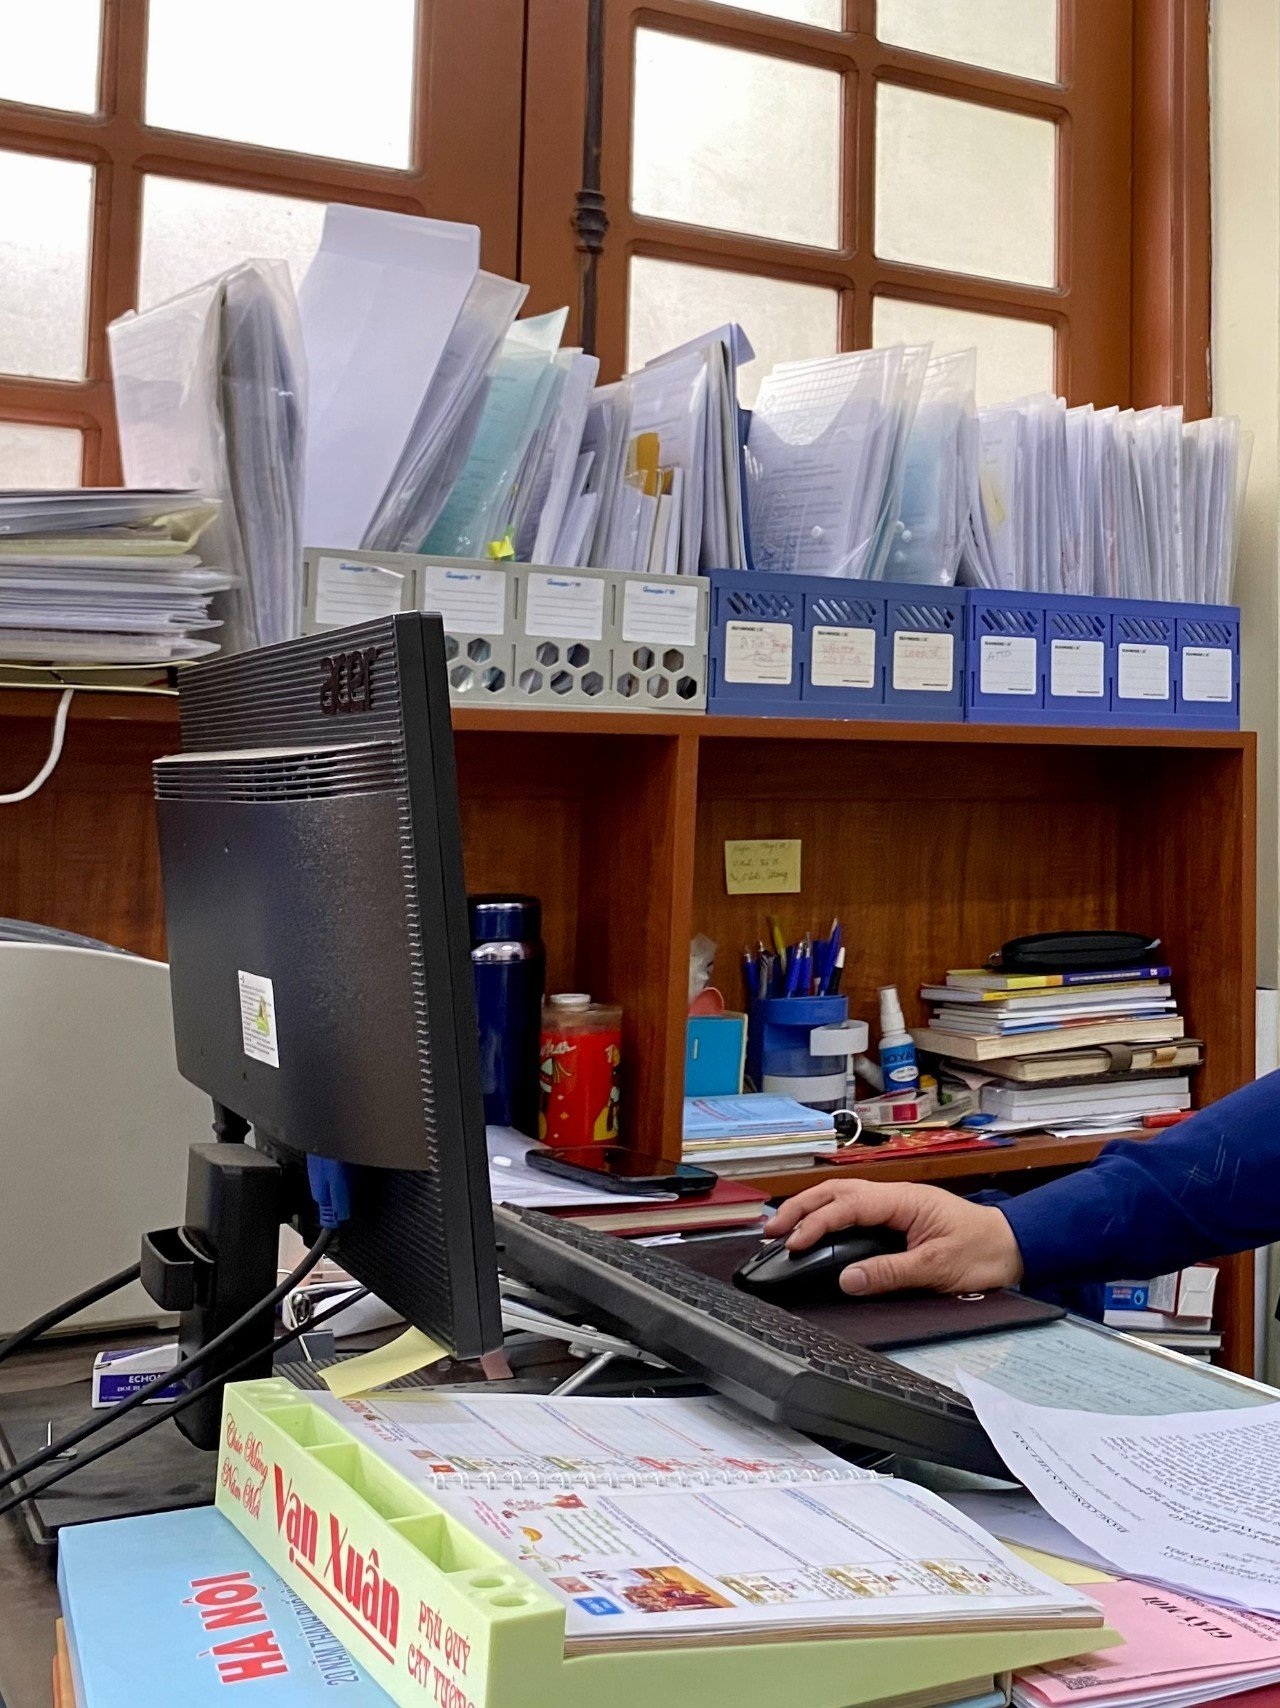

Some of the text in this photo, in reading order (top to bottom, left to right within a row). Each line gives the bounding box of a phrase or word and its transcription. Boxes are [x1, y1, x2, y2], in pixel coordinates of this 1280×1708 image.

[319, 646, 382, 716] acer
[226, 1412, 243, 1455] Chúc
[221, 1456, 241, 1500] Năm
[274, 1462, 401, 1648] Vạn Xuân
[181, 1571, 289, 1684] HÀ NỘI
[310, 1647, 353, 1673] NĂM
[323, 1669, 360, 1686] 20
[433, 1665, 475, 1708] TƯỜN
